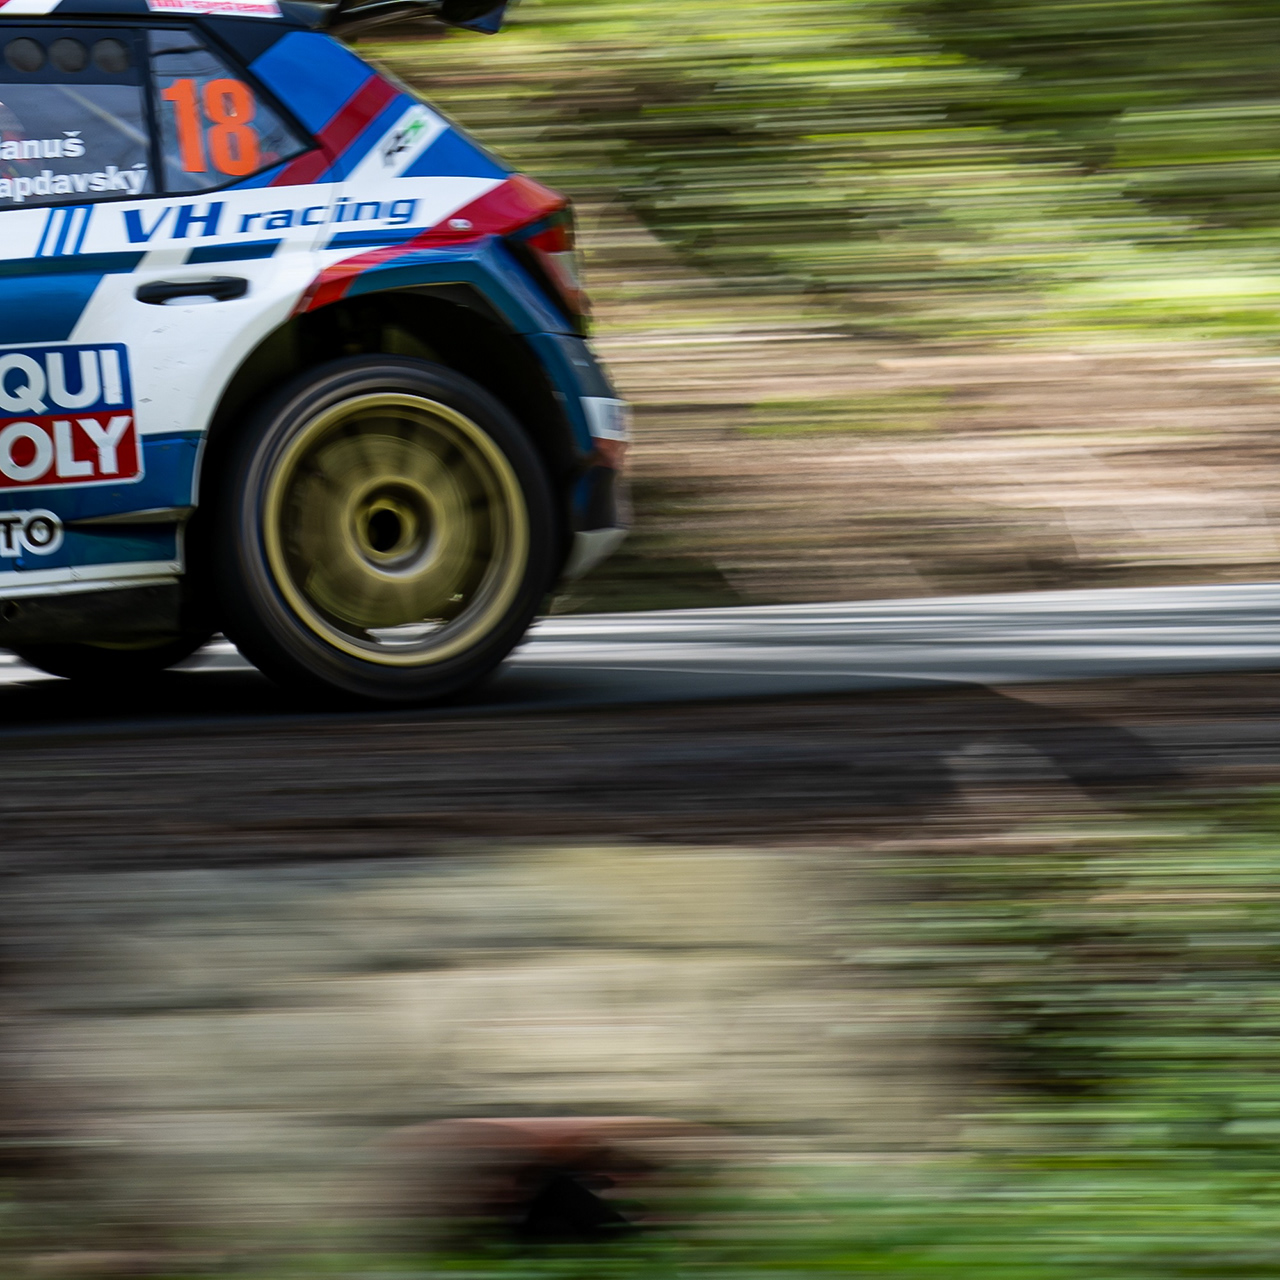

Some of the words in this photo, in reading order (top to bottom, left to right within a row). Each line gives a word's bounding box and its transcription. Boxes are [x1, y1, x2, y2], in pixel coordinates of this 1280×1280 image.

[161, 78, 261, 177] 18
[123, 201, 226, 243] VH
[238, 197, 423, 235] racing
